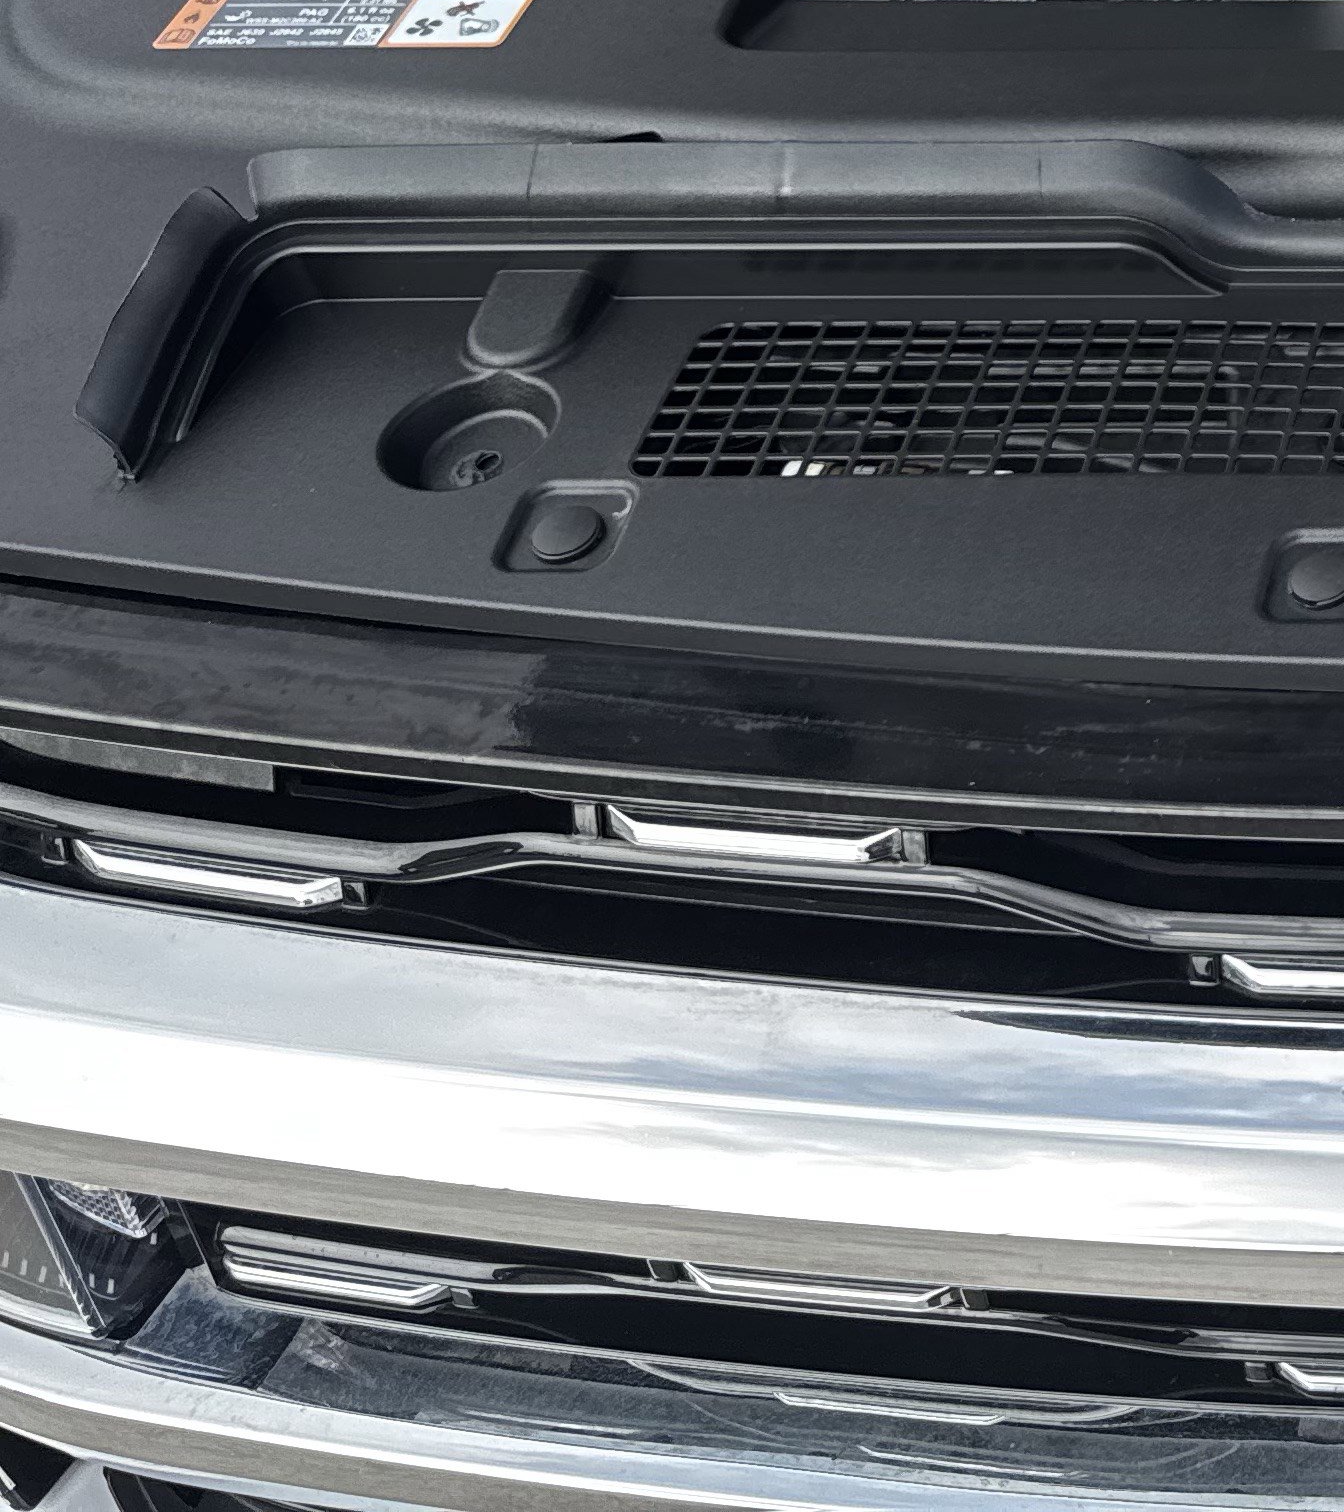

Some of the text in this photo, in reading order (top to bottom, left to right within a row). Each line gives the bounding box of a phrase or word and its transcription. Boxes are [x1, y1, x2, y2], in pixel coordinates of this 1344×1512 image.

[299, 8, 330, 17] PAG
[207, 28, 233, 36] SAE
[197, 36, 256, 46] FoMoCo
